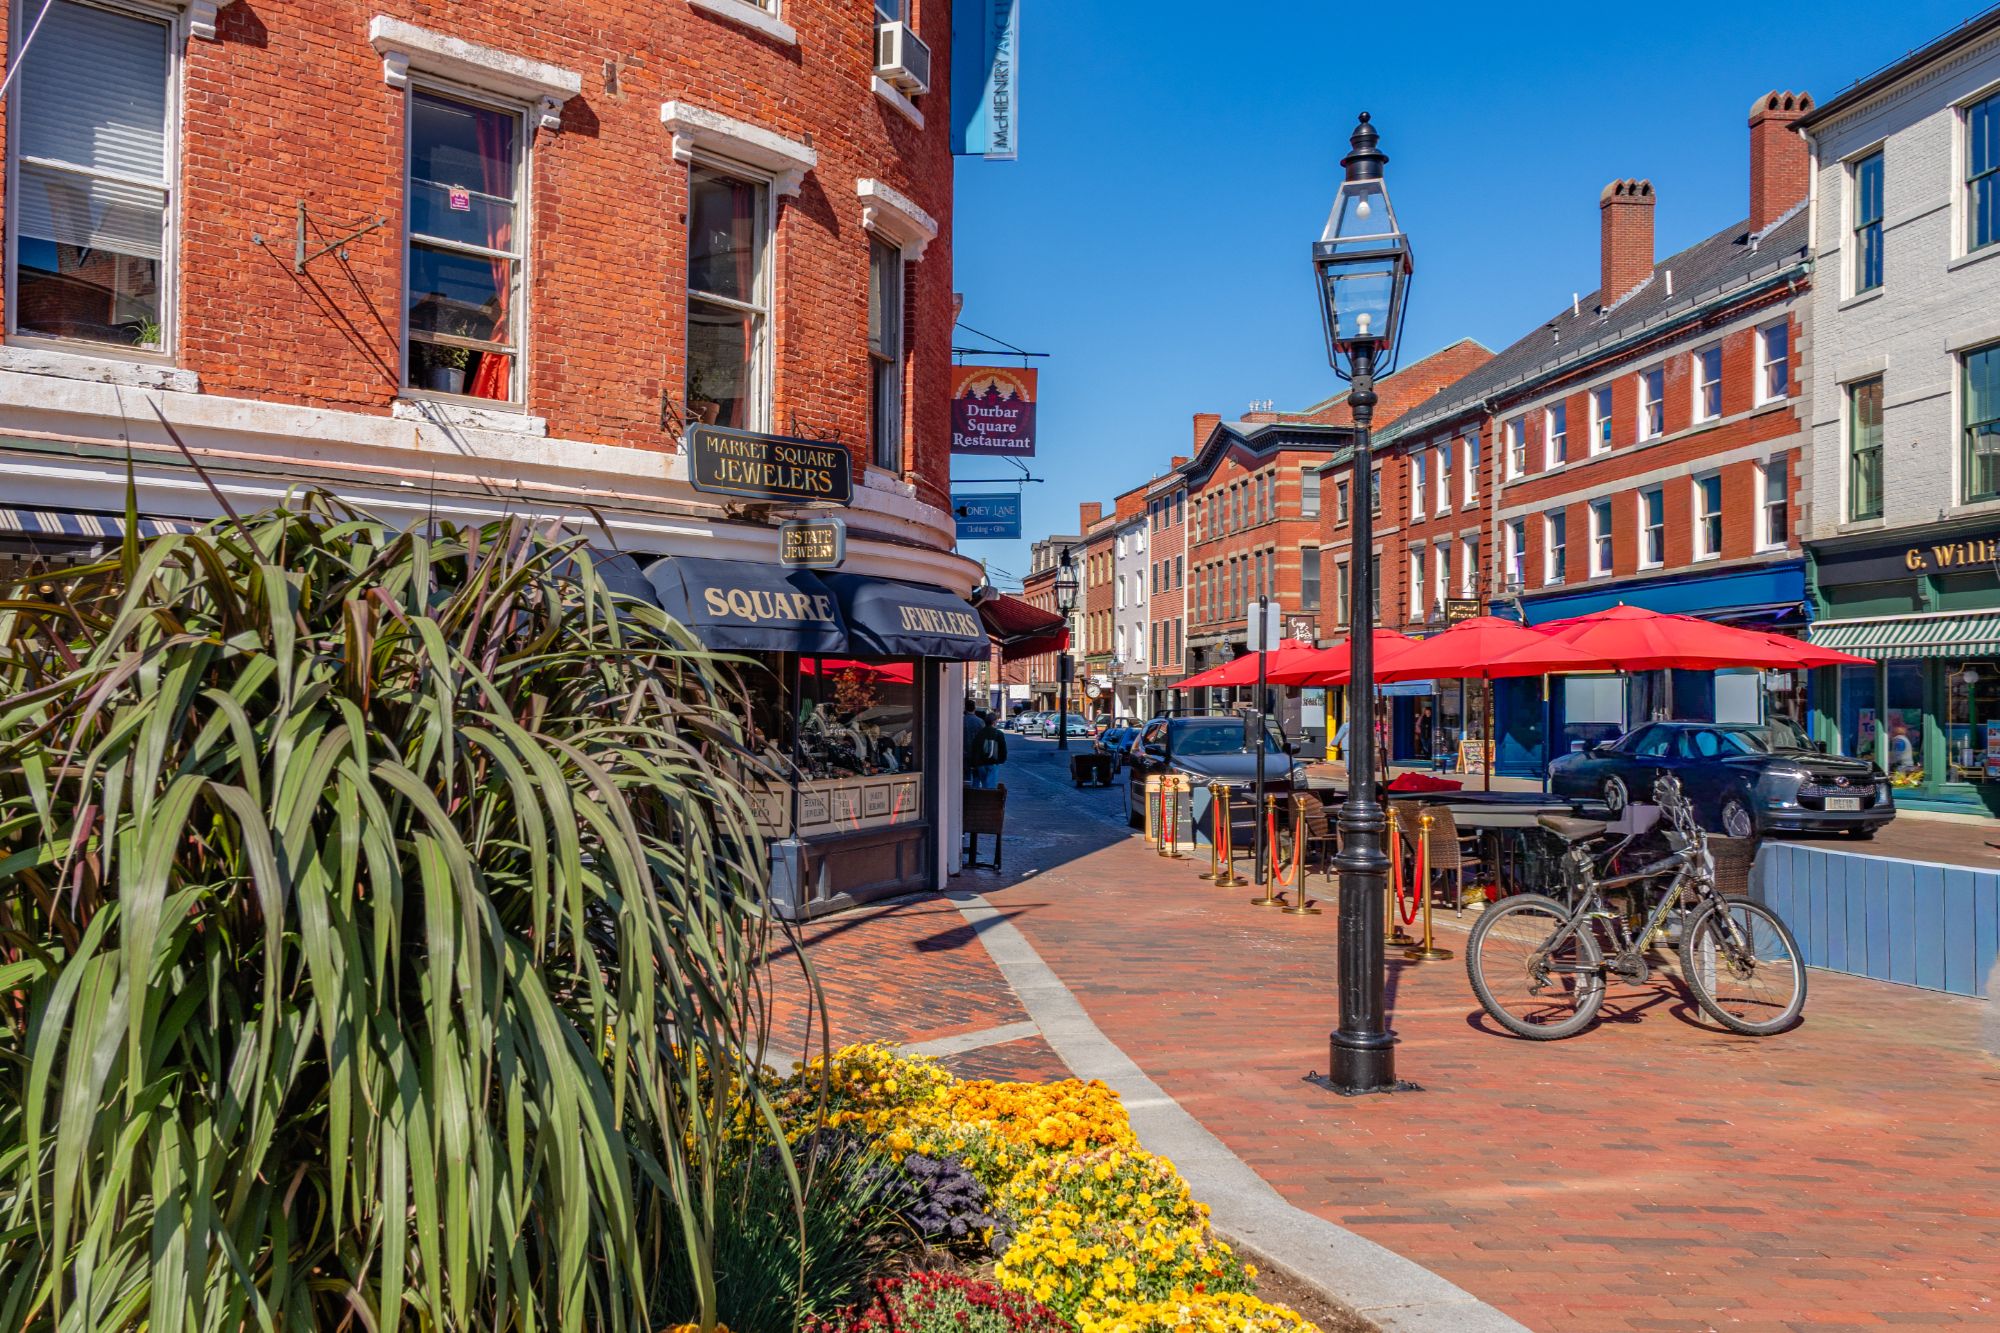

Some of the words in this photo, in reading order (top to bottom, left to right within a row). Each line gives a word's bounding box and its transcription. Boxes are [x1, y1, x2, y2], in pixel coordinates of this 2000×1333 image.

[967, 404, 1018, 418] Durbar
[967, 418, 1017, 435] Square
[953, 433, 1031, 449] Restaurant
[706, 436, 769, 460] MARKET
[774, 446, 837, 468] SQUARE
[714, 457, 833, 493] JEWELERS
[992, 504, 1016, 518] LANE
[786, 529, 833, 545] ESTATE
[784, 544, 833, 558] JEWELRY
[1905, 549, 1927, 570] G.
[704, 587, 835, 623] SQUARE
[898, 605, 980, 637] JEWELERS
